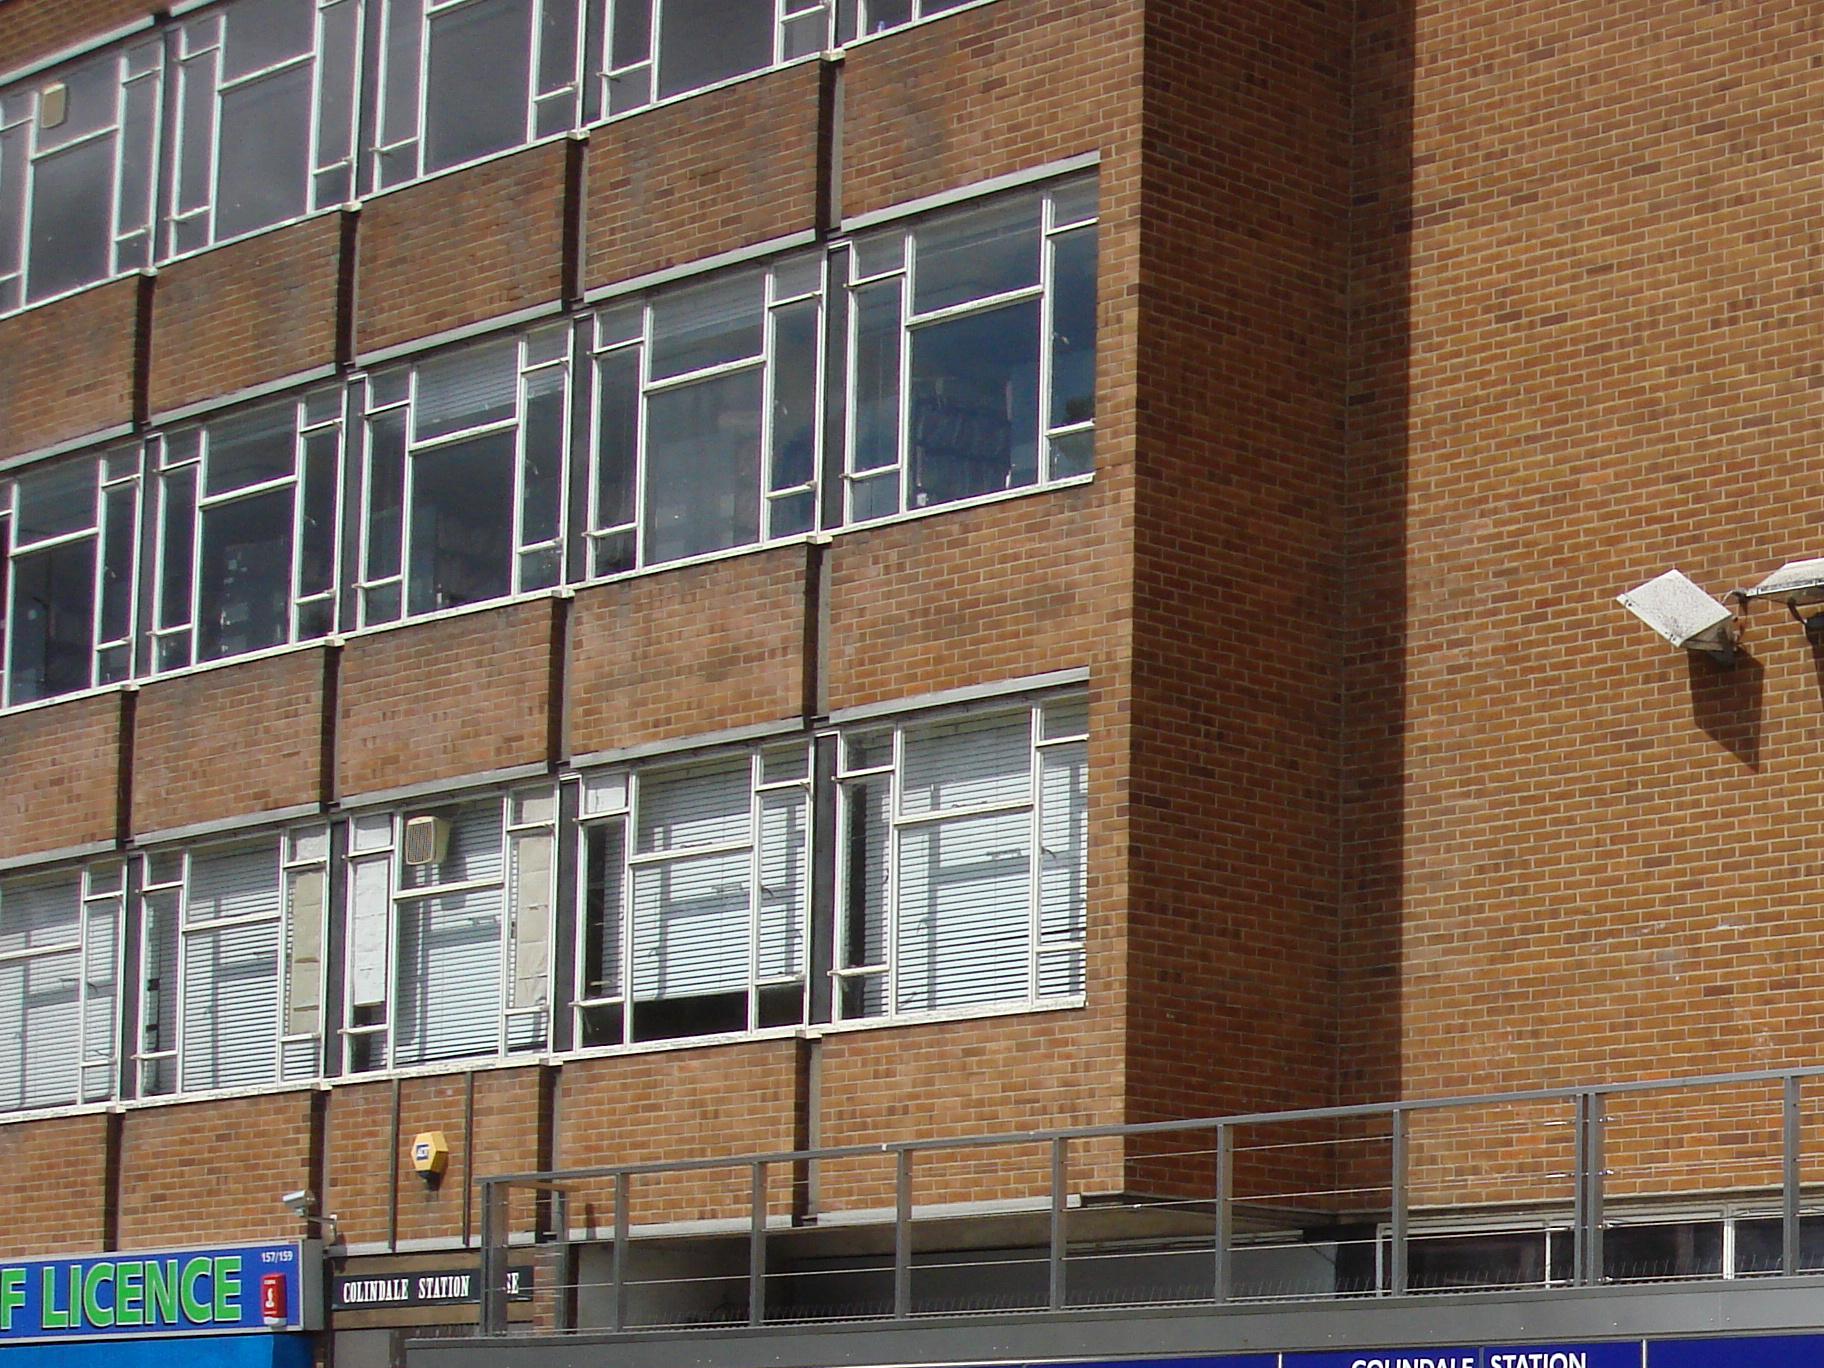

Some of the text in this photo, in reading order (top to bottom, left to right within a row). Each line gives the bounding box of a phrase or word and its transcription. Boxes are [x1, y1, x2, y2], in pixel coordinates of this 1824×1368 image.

[260, 1250, 294, 1263] 157/159
[41, 1254, 243, 1330] LICENCE
[343, 1275, 471, 1304] COLINDALE STATION
